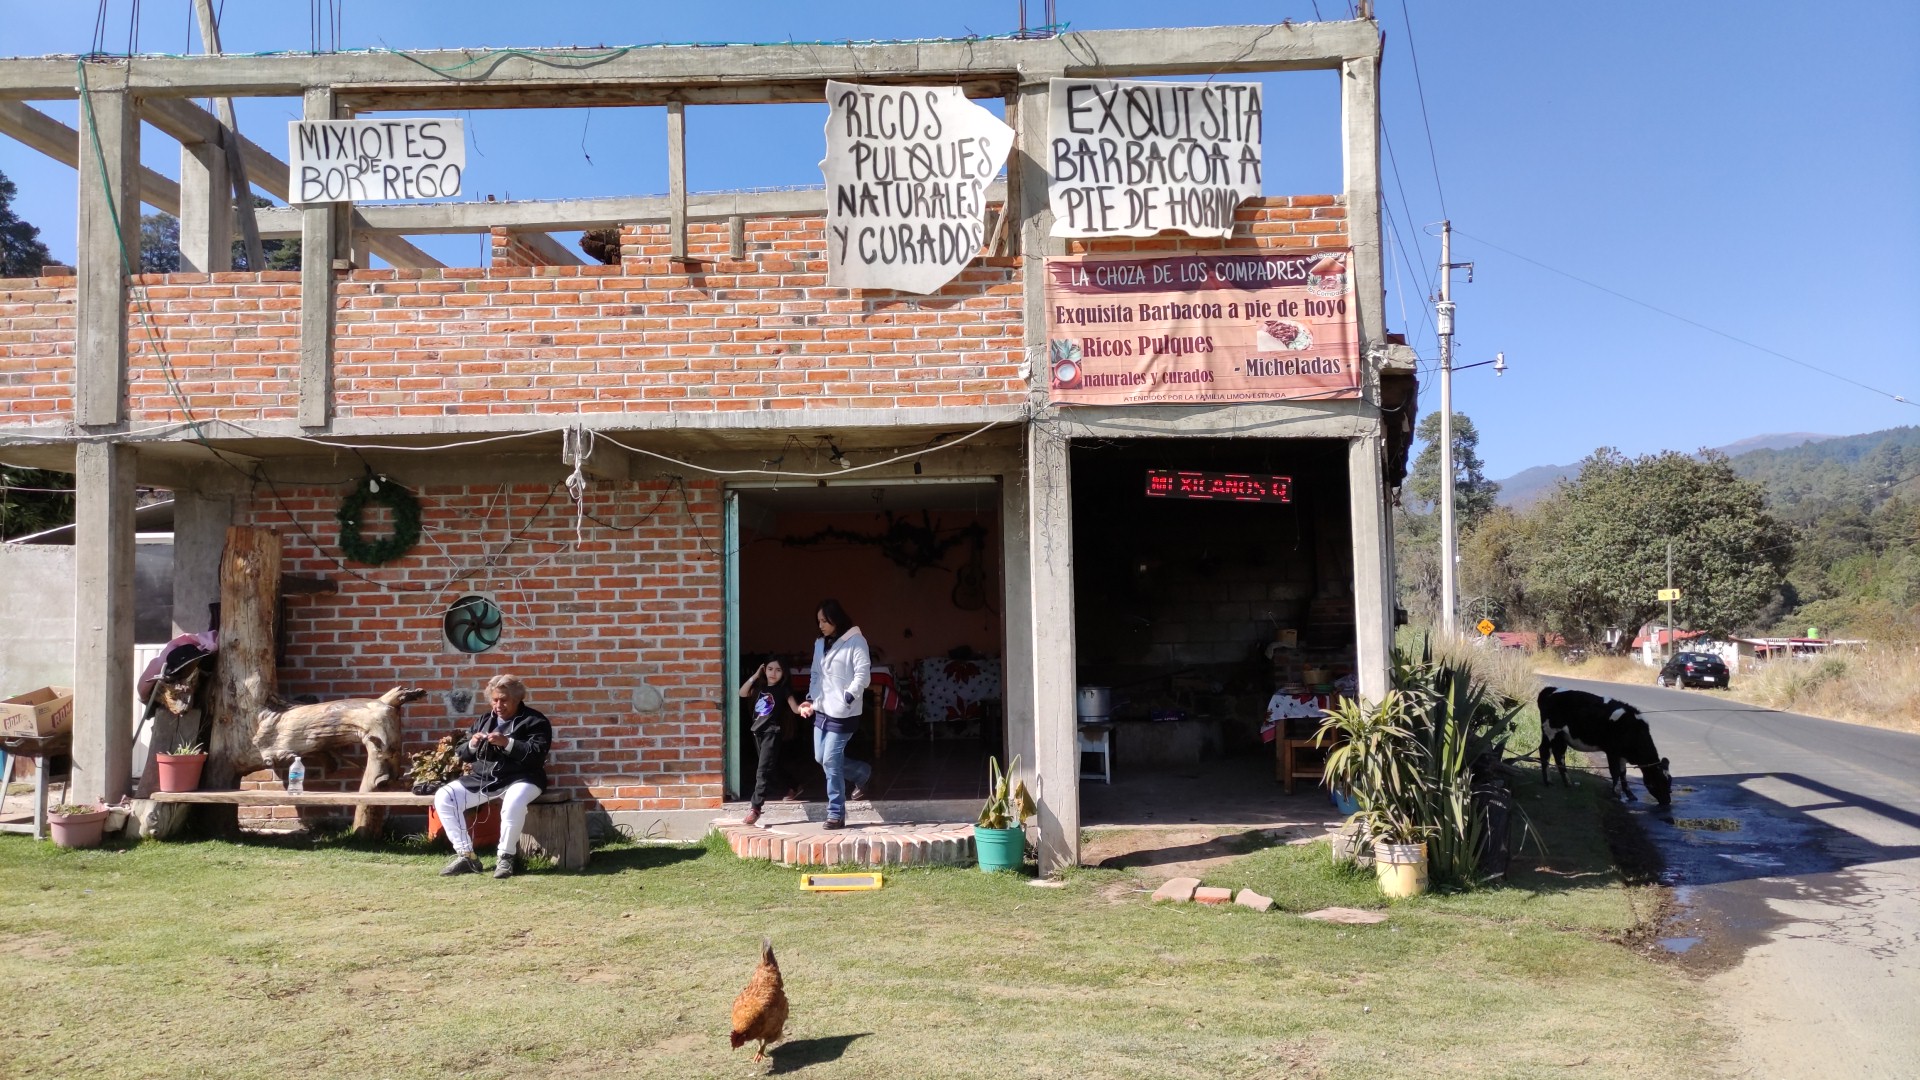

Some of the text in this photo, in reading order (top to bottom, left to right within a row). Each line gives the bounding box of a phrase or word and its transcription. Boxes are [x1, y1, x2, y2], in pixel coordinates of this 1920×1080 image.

[838, 90, 942, 141] RICOS
[1067, 83, 1262, 144] EXQUISITA
[299, 122, 447, 161] MIXIOTES
[848, 136, 993, 182] PULQUES
[359, 156, 382, 174] DE
[1052, 137, 1261, 186] BARBACOA A
[837, 178, 983, 219] NATURALES
[1059, 186, 1240, 232] PIE DE HORNO
[833, 222, 982, 266] Y CURADOS
[1071, 259, 1306, 287] LA CHOZA DE LOS COMPADRES
[1055, 298, 1347, 326] Exquisita Barbacoa a pie de hoyo
[1083, 334, 1214, 357] Ricos Pulques
[1084, 369, 1215, 387] naturales y curados
[1246, 357, 1341, 377] Micheladas
[1184, 393, 1194, 401] LA
[1195, 393, 1225, 401] FAMILIA
[1252, 391, 1287, 399] ESTRADA
